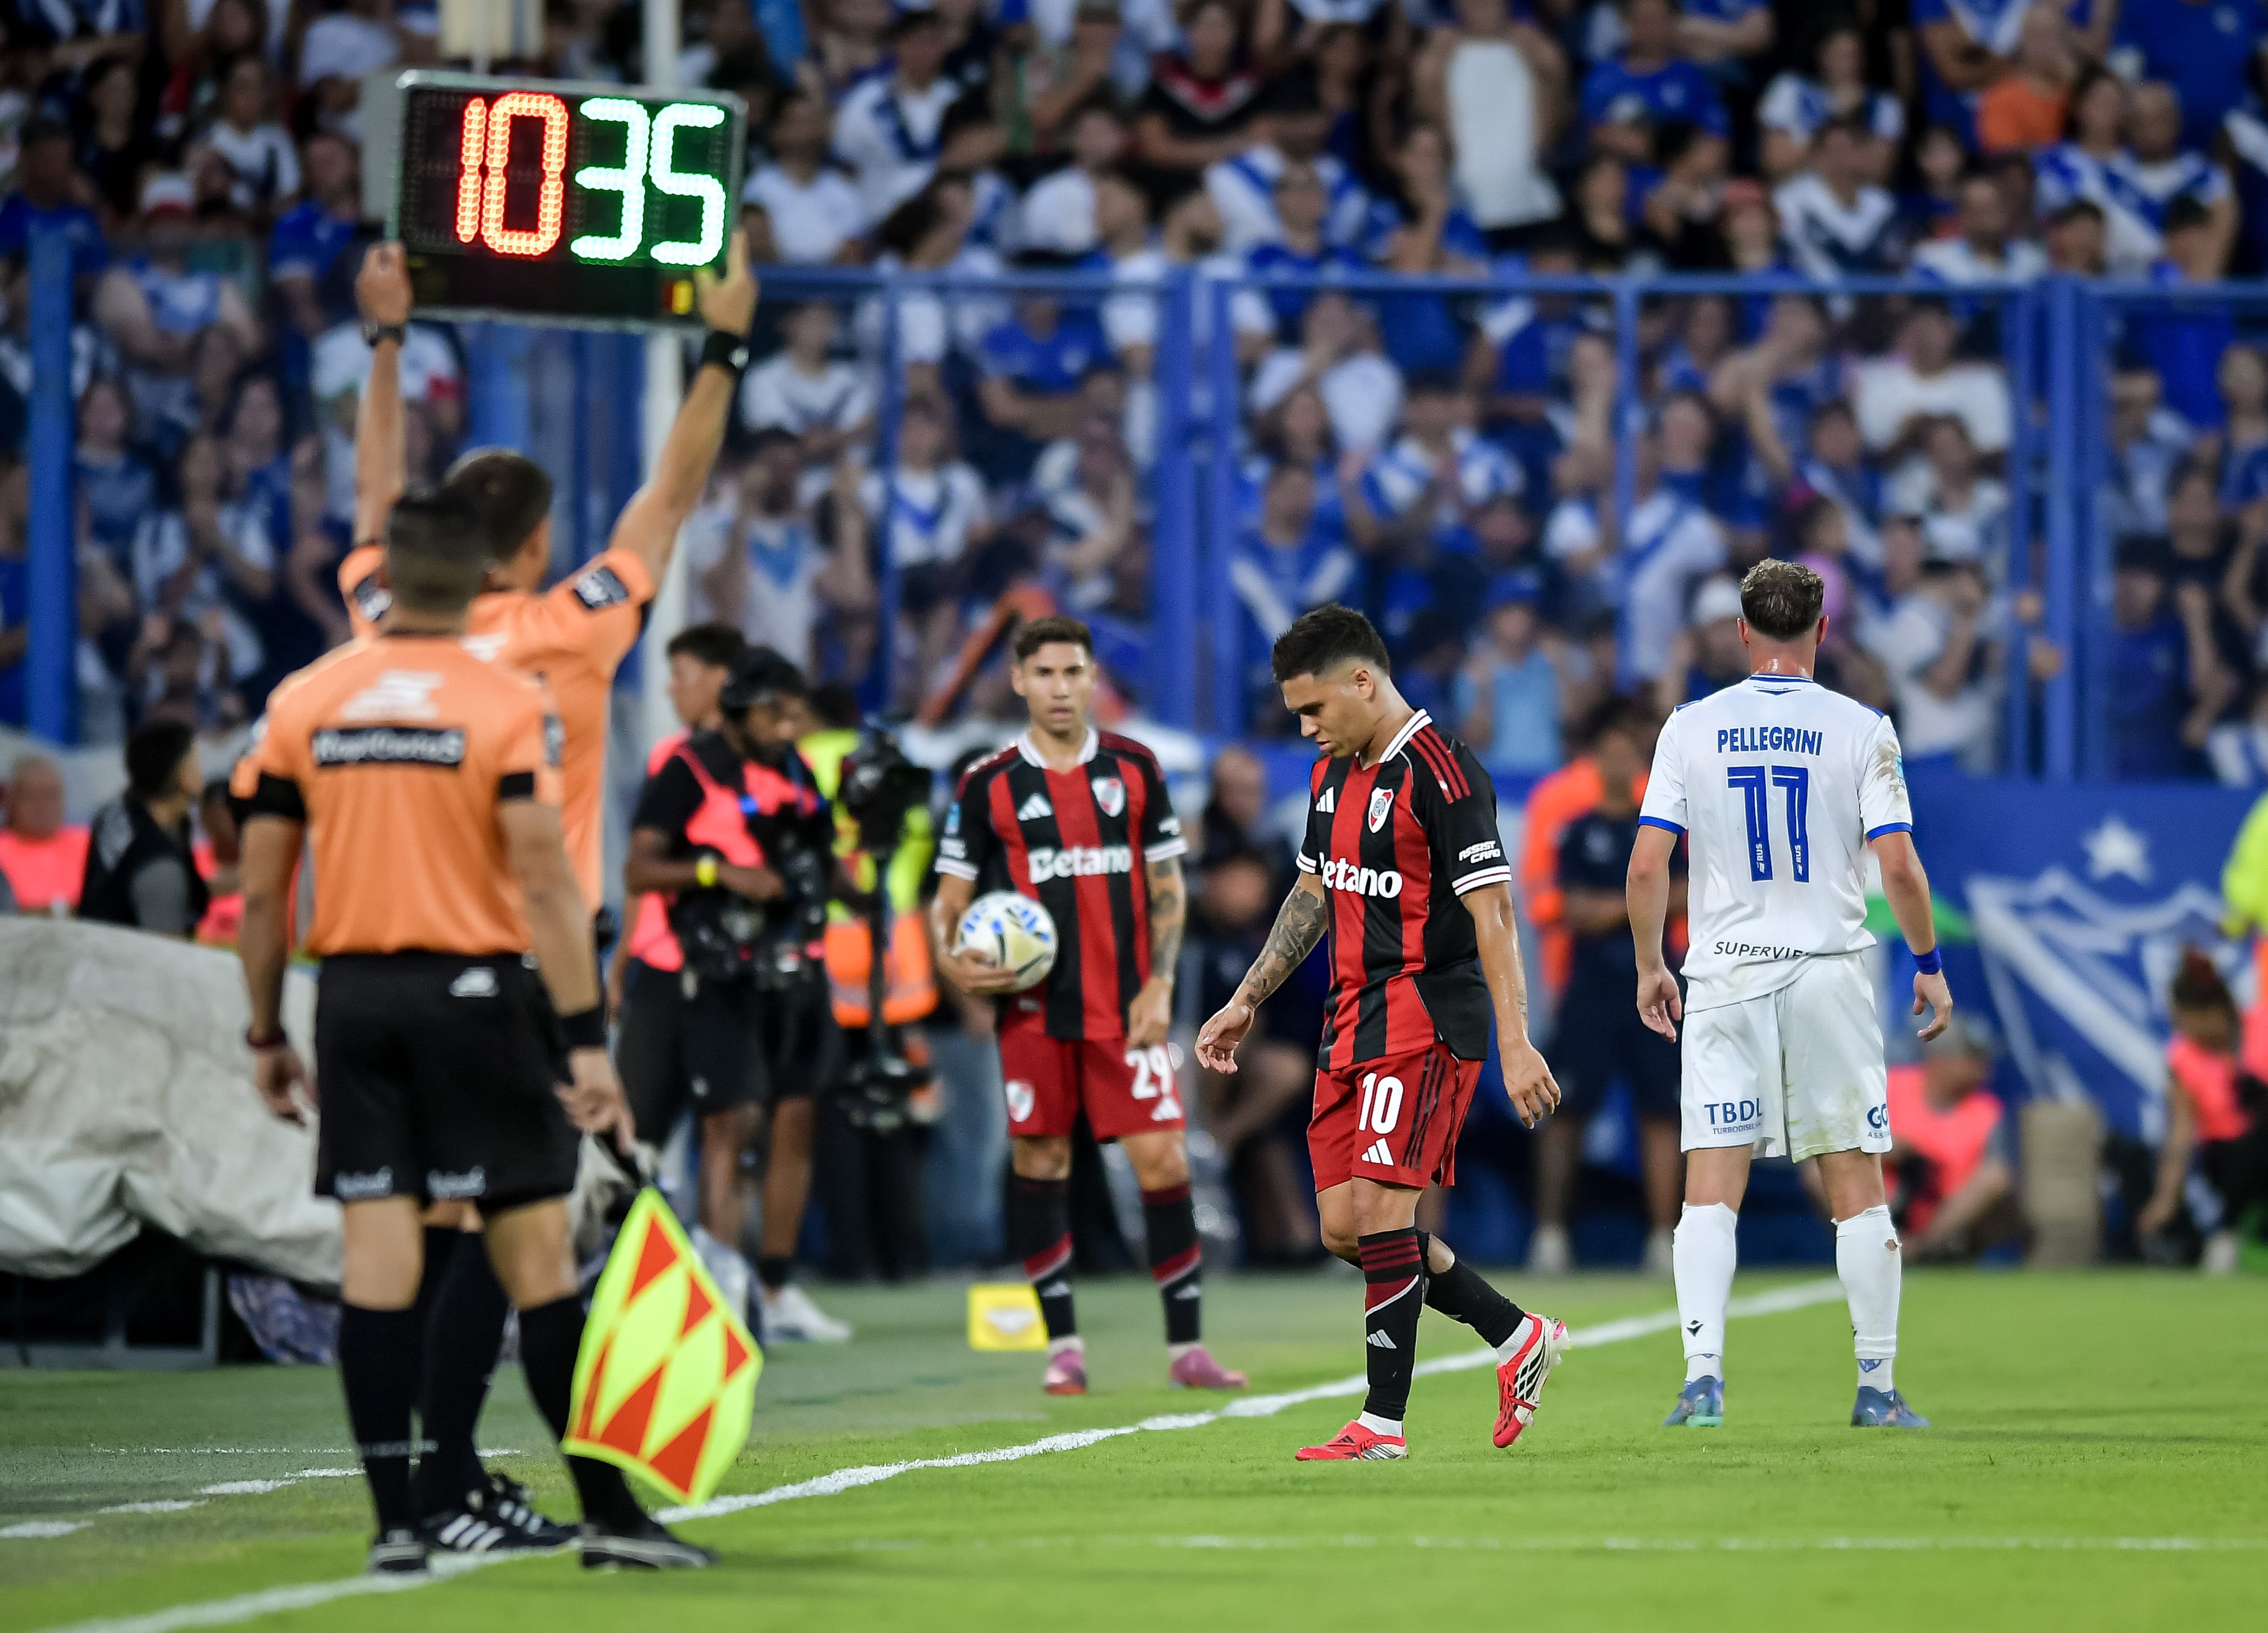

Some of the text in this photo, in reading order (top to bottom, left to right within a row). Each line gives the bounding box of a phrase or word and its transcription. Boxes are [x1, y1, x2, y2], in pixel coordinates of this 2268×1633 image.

[456, 93, 726, 266] 10 35
[1718, 726, 1822, 756] PELLEGRINI
[1319, 852, 1402, 899] etano
[1714, 942, 1809, 959] SUPERVIE
[1126, 1046, 1172, 1100] 29
[1358, 1072, 1404, 1134] 10
[1704, 1097, 1763, 1125] TBDL
